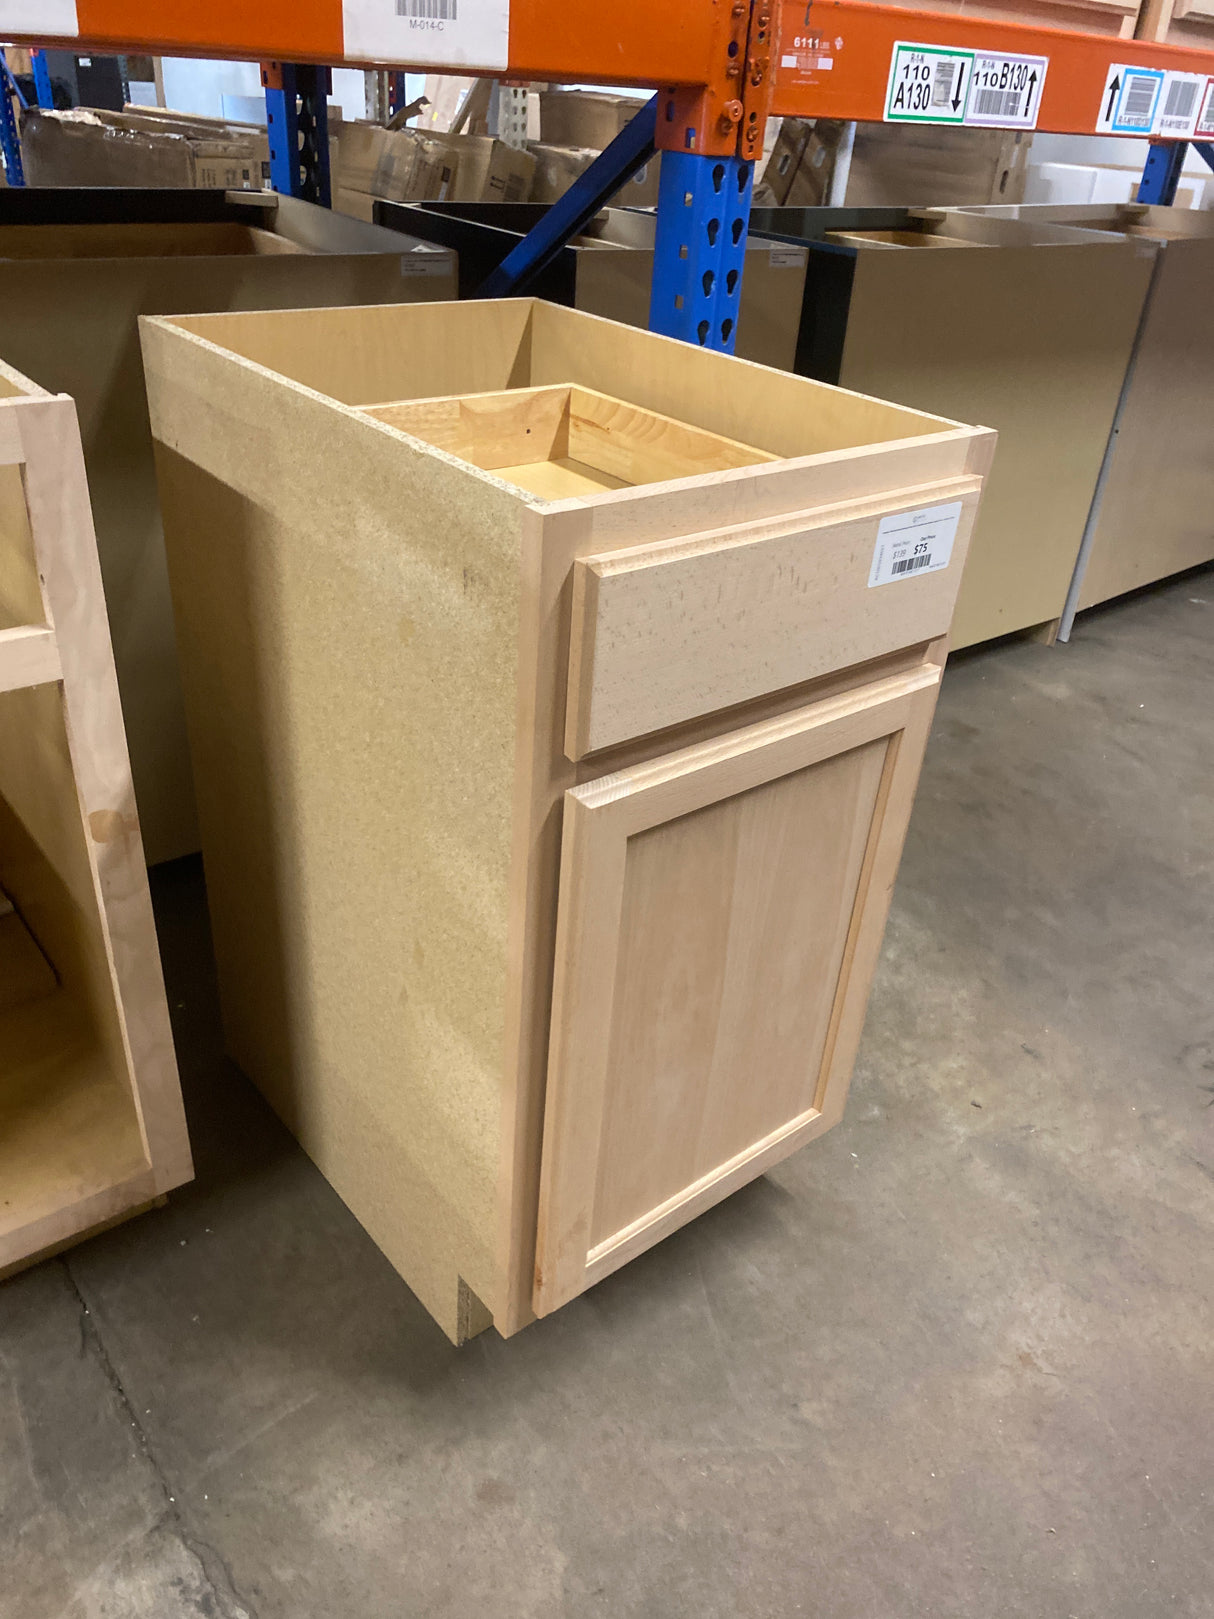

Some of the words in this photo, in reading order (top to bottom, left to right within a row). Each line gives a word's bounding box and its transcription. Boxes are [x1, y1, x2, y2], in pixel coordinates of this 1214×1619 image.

[409, 19, 444, 31] M-014-C
[794, 36, 819, 49] 6111
[903, 64, 930, 81] 110
[973, 71, 998, 87] 110
[999, 62, 1028, 91] B130
[893, 81, 931, 110] A130
[913, 542, 928, 555] $75
